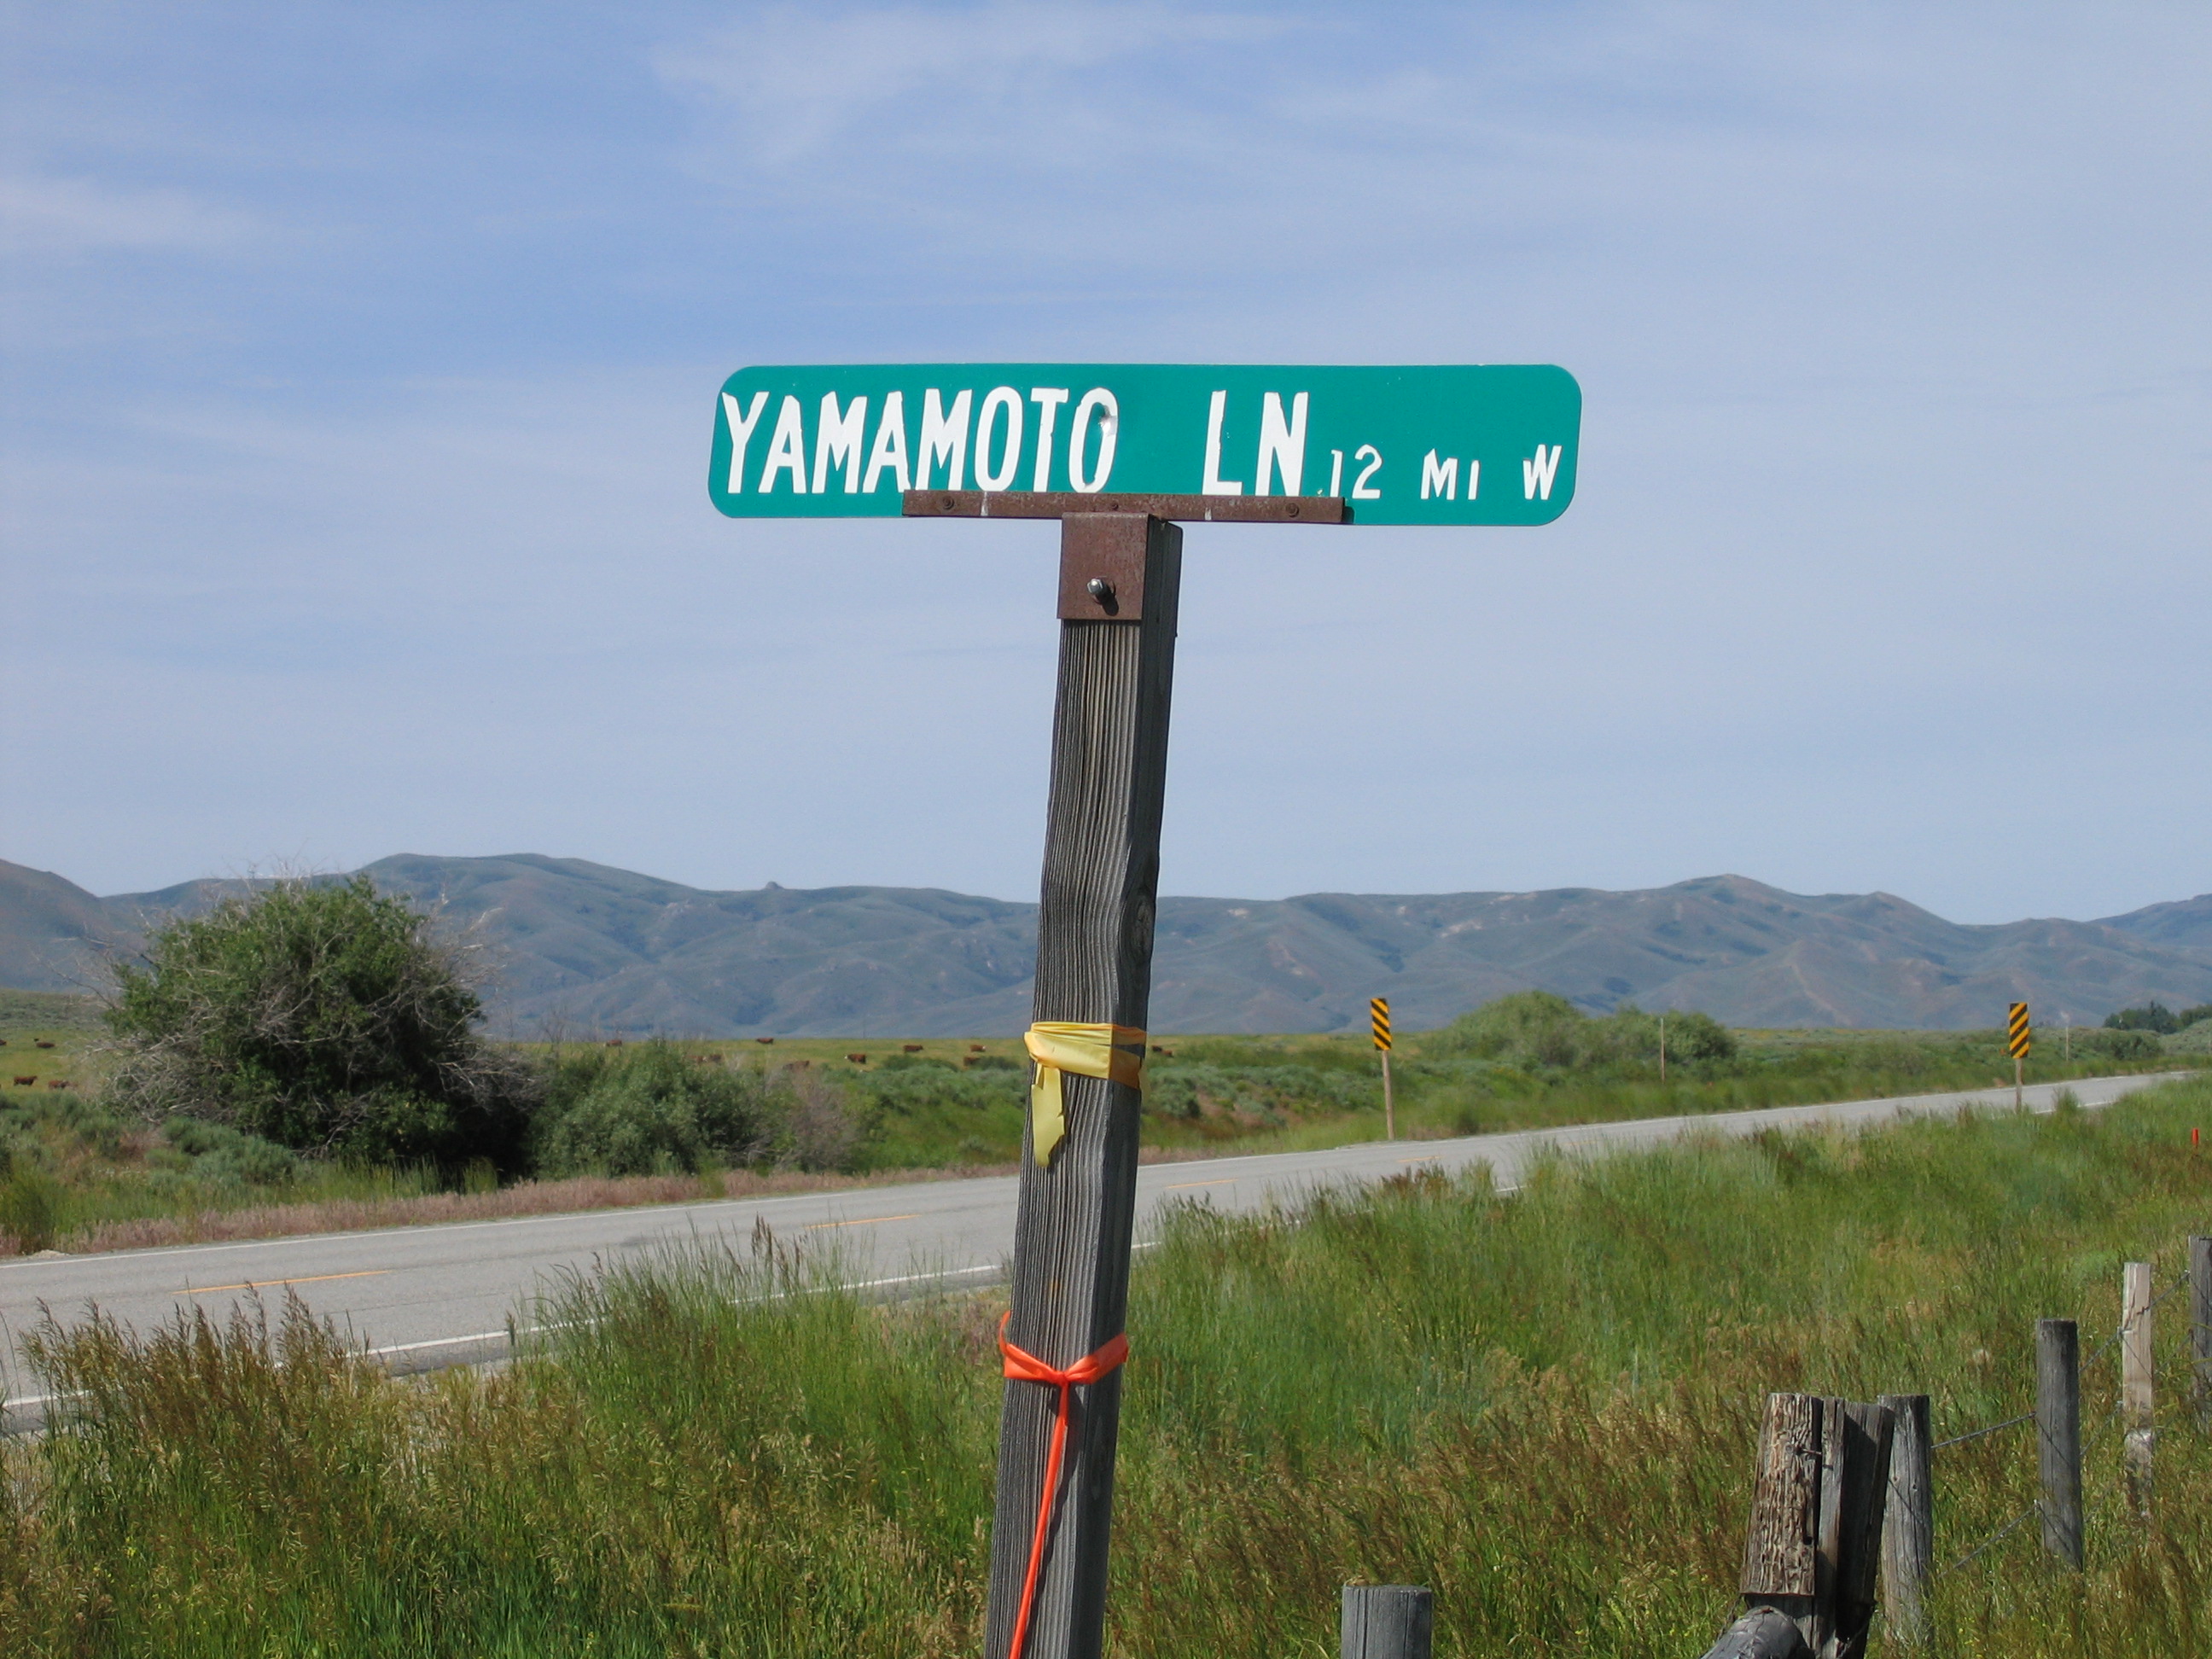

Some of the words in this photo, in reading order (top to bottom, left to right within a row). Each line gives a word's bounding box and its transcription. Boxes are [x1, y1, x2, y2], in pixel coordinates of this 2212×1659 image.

[721, 386, 1119, 494] YAMAMOTO
[1202, 390, 1309, 497] LN
[1330, 444, 1383, 498] 12
[1420, 447, 1481, 500] MI
[1522, 444, 1563, 500] W
